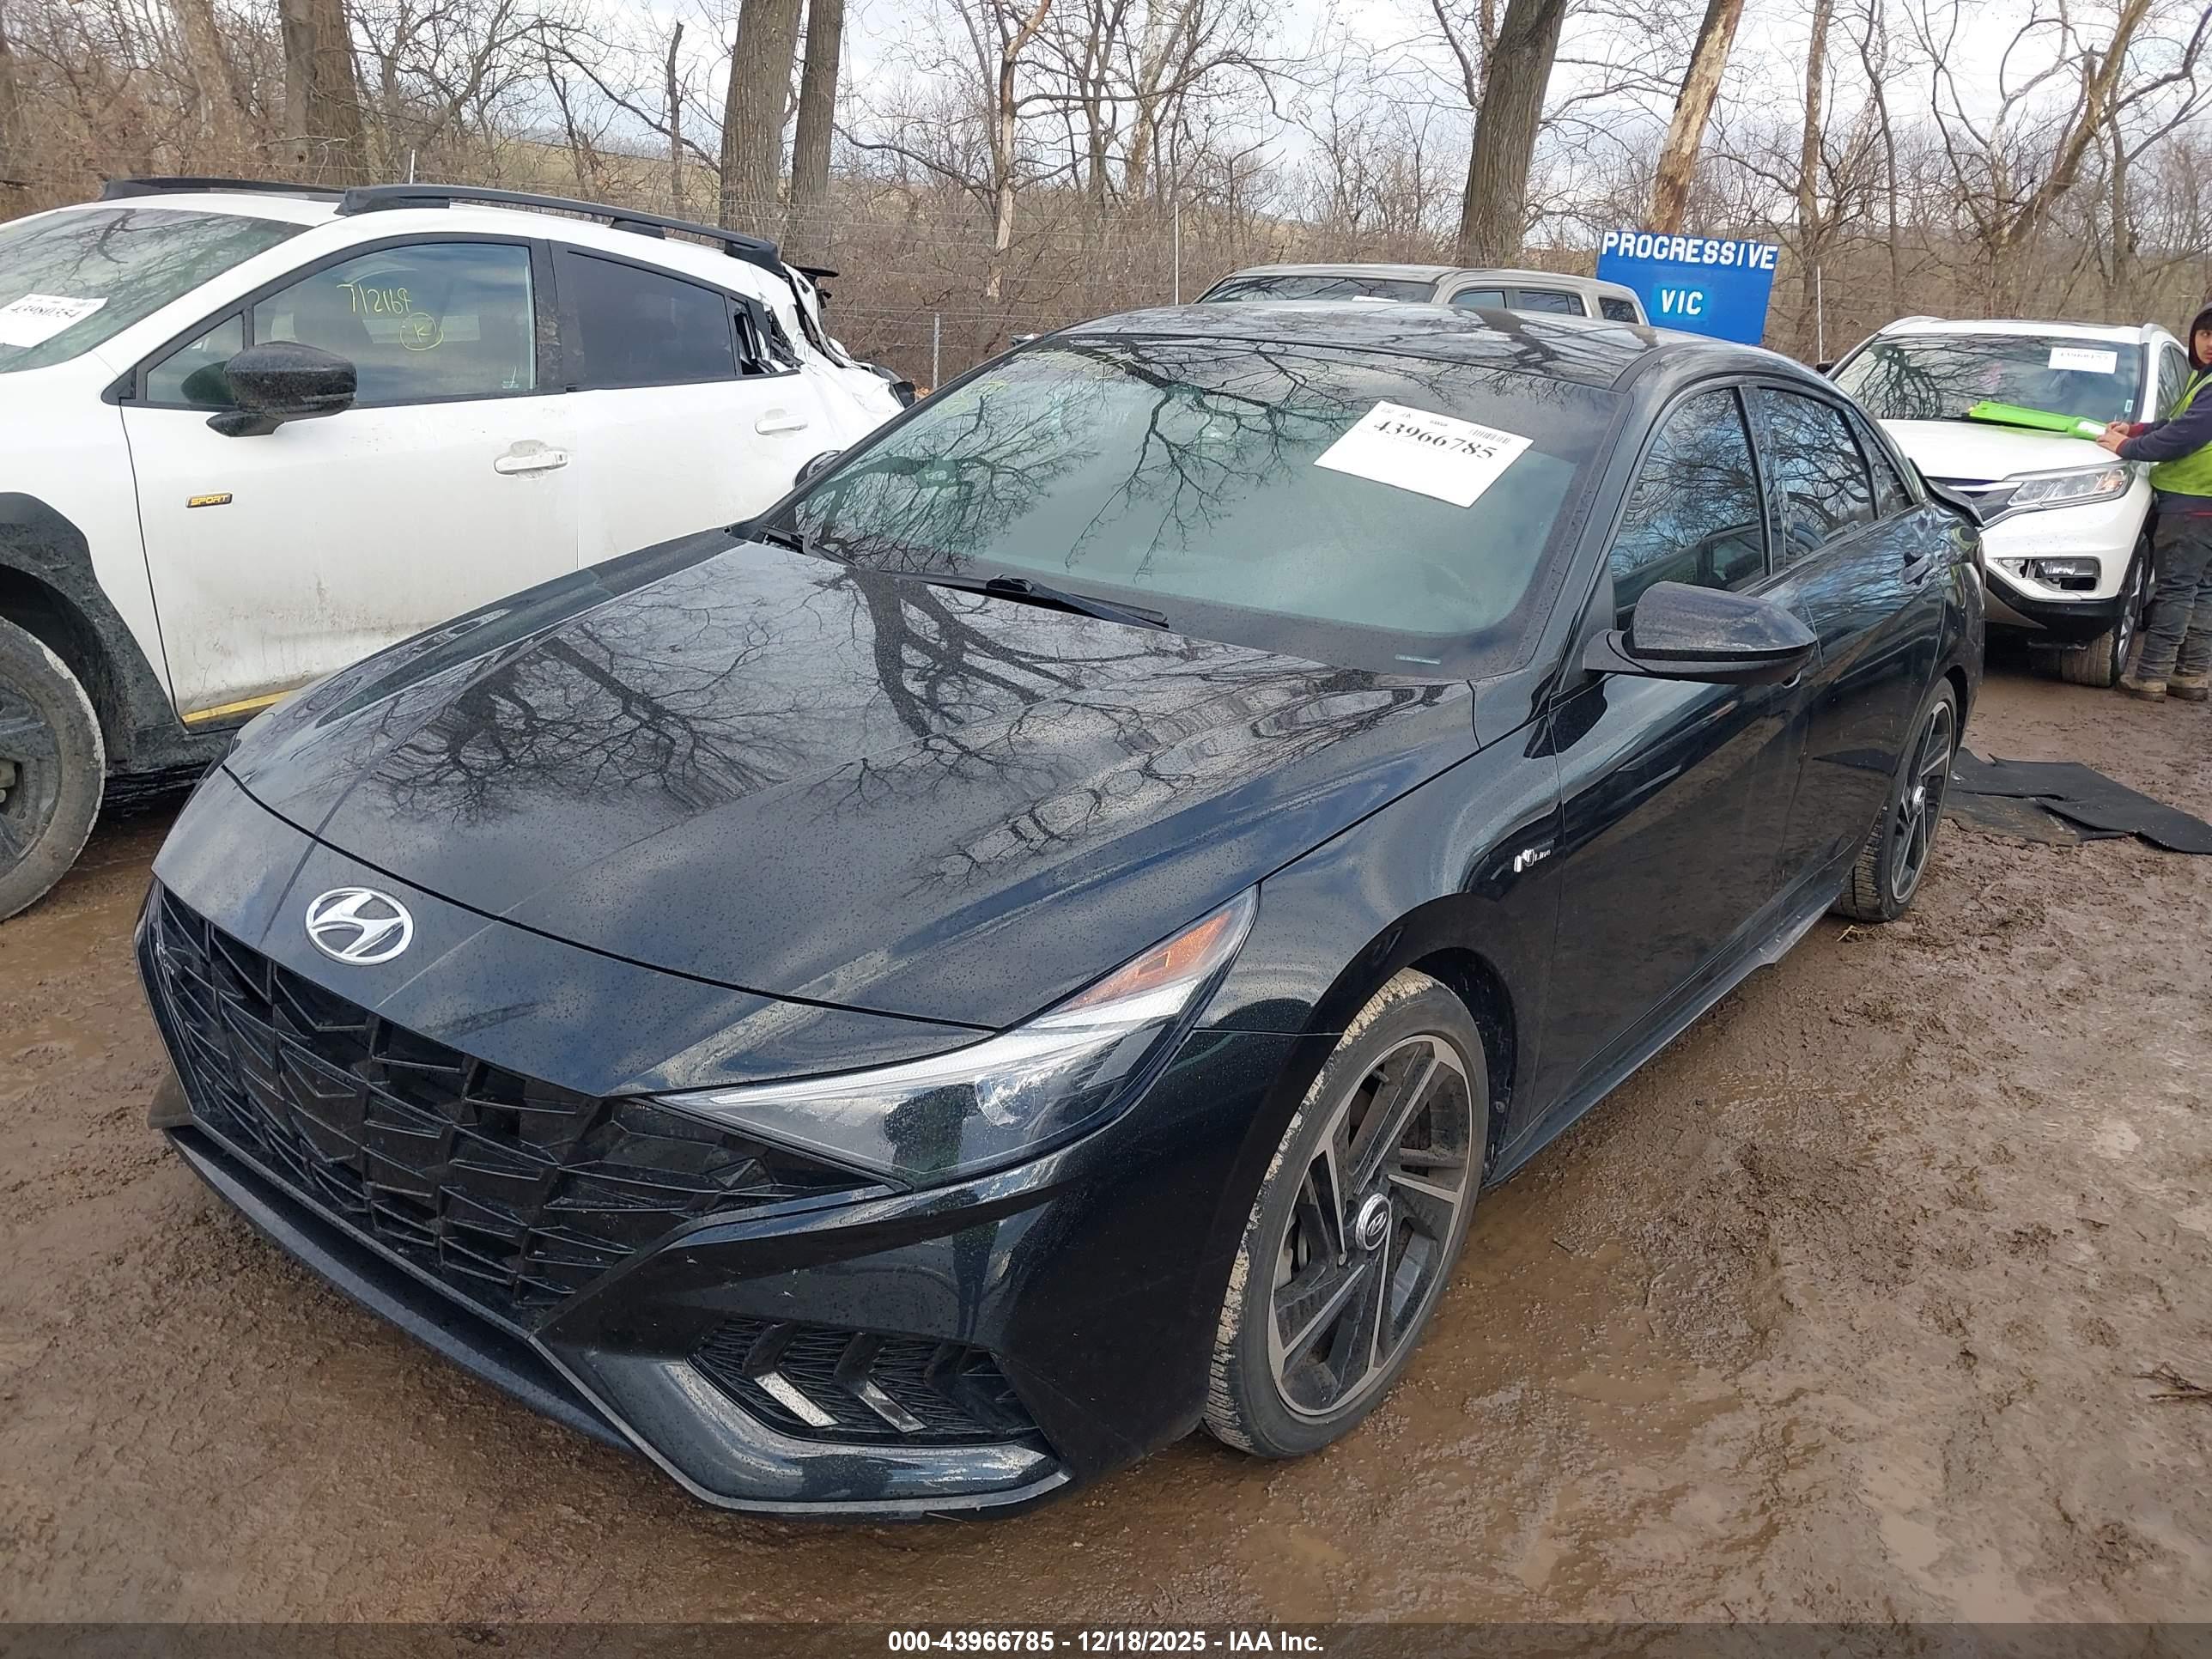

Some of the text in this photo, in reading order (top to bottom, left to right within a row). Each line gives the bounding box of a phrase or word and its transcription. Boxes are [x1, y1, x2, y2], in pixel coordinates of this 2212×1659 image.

[1602, 231, 1778, 270] PROGRESSIVE
[1662, 289, 1704, 315] VIC
[1373, 420, 1498, 459] 43966785
[191, 495, 228, 506] SPORT
